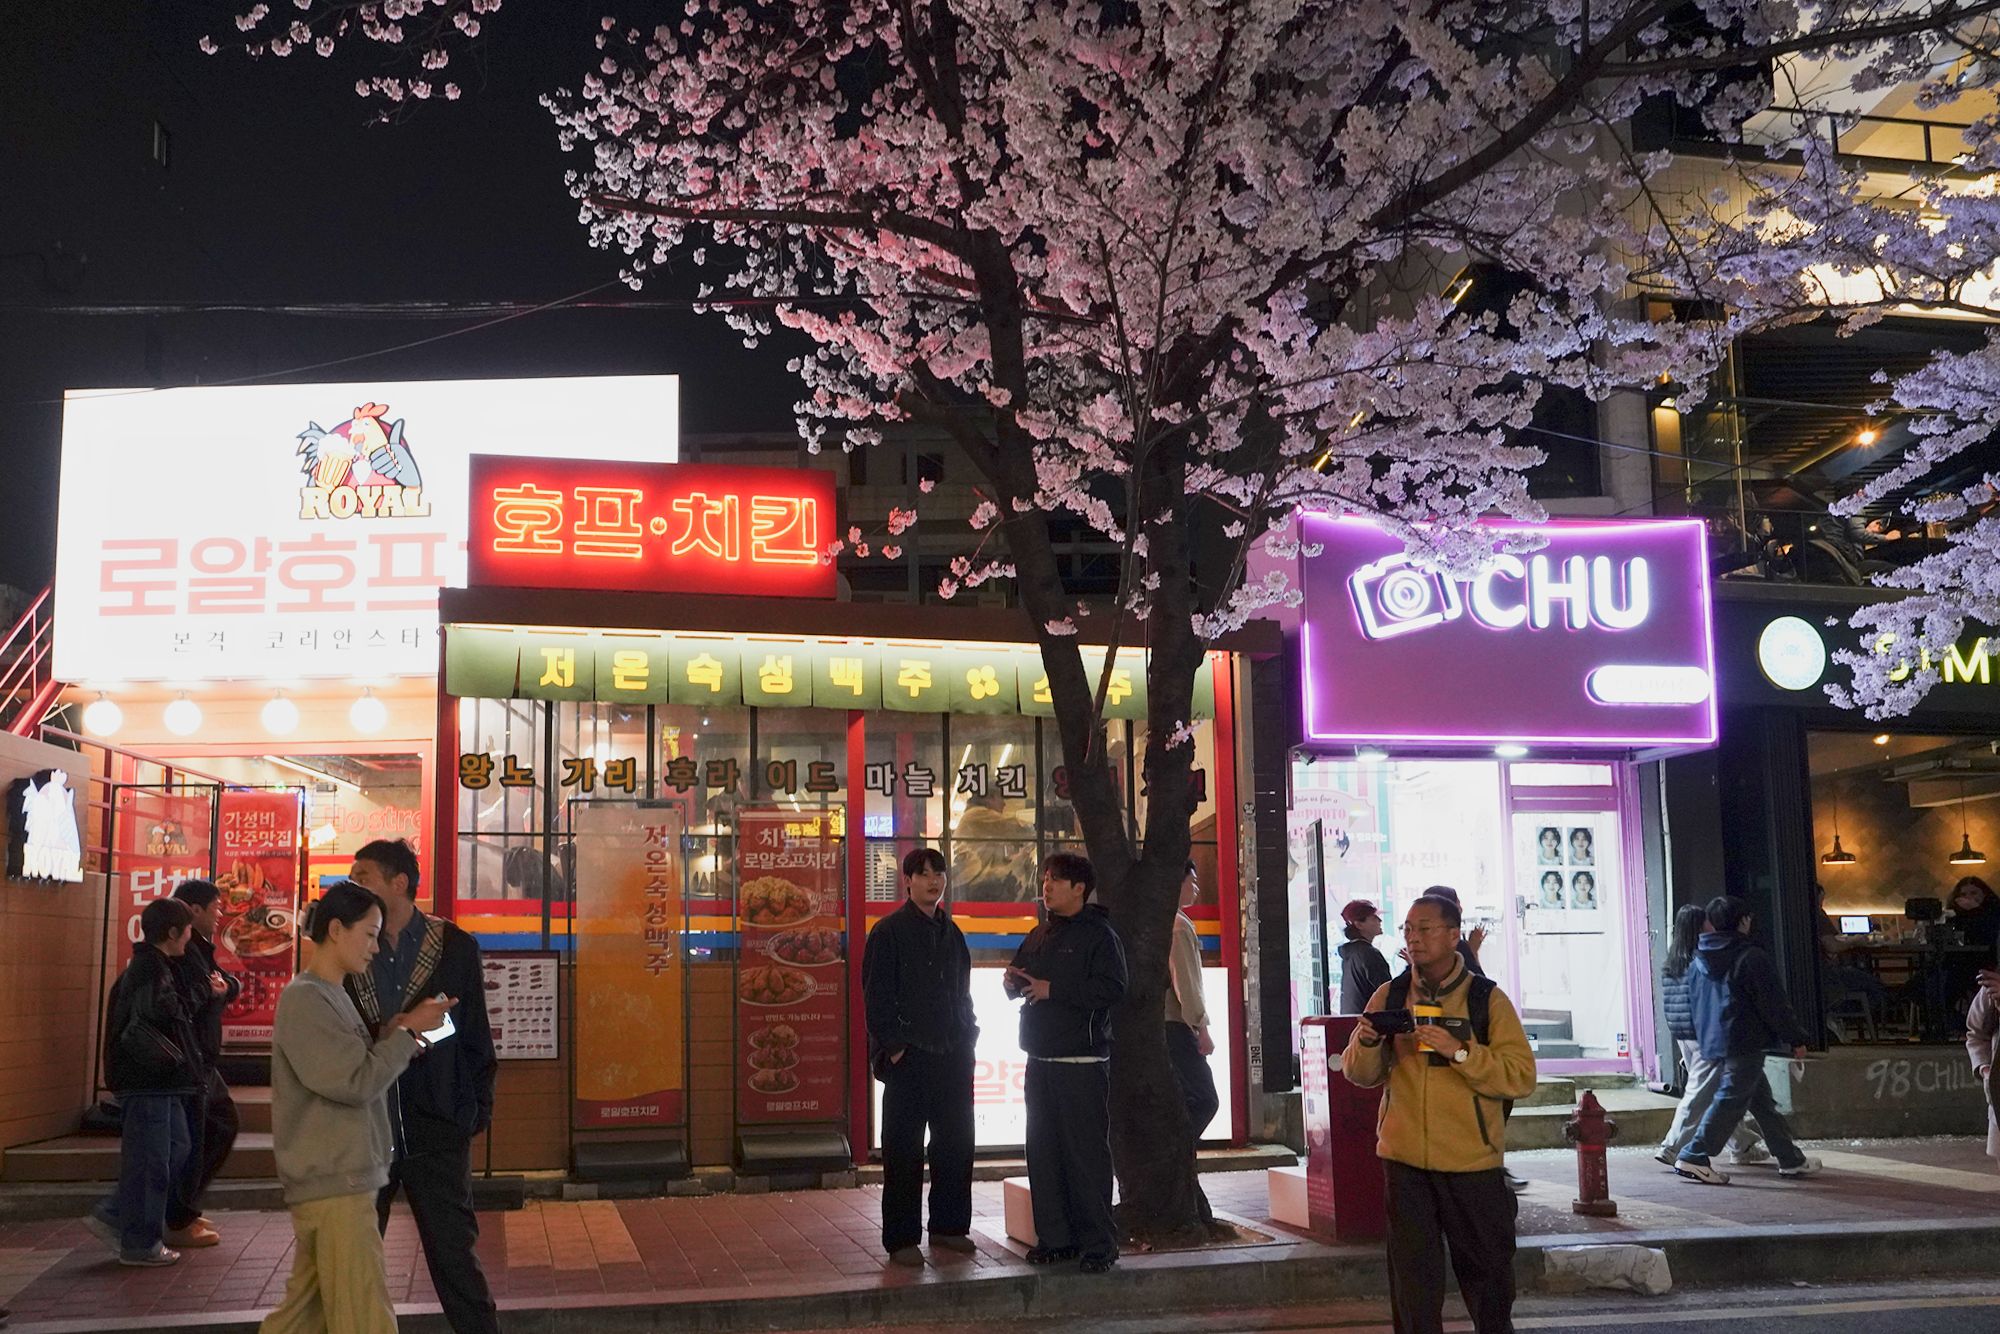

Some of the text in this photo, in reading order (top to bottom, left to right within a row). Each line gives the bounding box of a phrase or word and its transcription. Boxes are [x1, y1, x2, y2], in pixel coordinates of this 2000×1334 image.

[299, 485, 432, 520] ROYAL
[99, 532, 467, 618] 로얄호프
[1469, 553, 1650, 631] CHU
[171, 628, 226, 653] 본격
[224, 811, 276, 829] 가성비
[224, 830, 292, 848] 안주맛집
[743, 851, 837, 870] 로얄호프치킨
[643, 824, 671, 978] 저온숙성맥주
[1865, 1058, 1983, 1099] 98 CHIL
